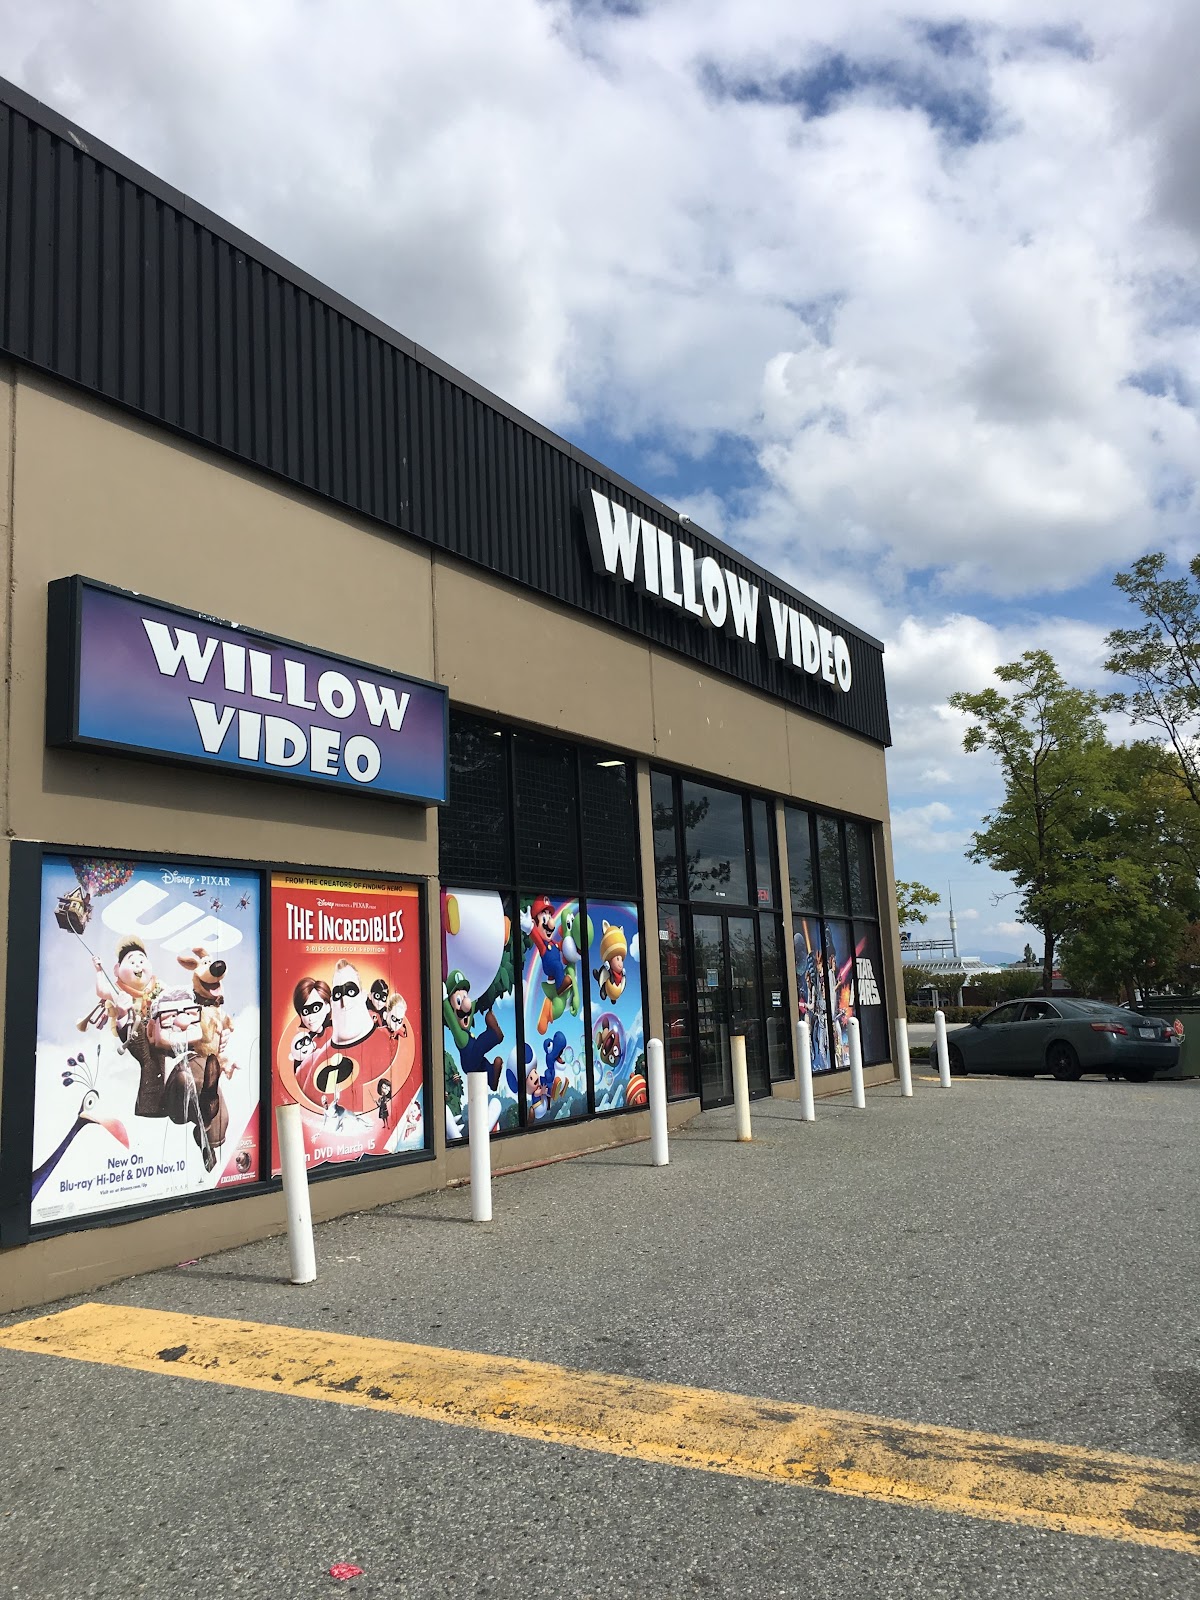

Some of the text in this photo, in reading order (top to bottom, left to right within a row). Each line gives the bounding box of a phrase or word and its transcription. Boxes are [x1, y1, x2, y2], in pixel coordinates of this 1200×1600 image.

[591, 489, 852, 693] WILLOW VIDEO
[141, 617, 411, 732] WILLOW
[188, 697, 382, 784] VIDEO
[201, 876, 231, 887] PIXAR
[285, 876, 304, 885] FROM
[306, 878, 318, 886] THE
[319, 879, 353, 889] CREATORS
[362, 883, 386, 891] FINDING
[757, 889, 769, 901] PEN
[285, 902, 404, 943] THE INCREDIBLES
[856, 957, 876, 979] TAR
[314, 1147, 333, 1160] DVD
[336, 1143, 363, 1156] March
[367, 1139, 376, 1151] 15
[107, 1154, 144, 1170] New On
[59, 1160, 186, 1193] Blu-ray Hi-Def & DVD Nov. 10
